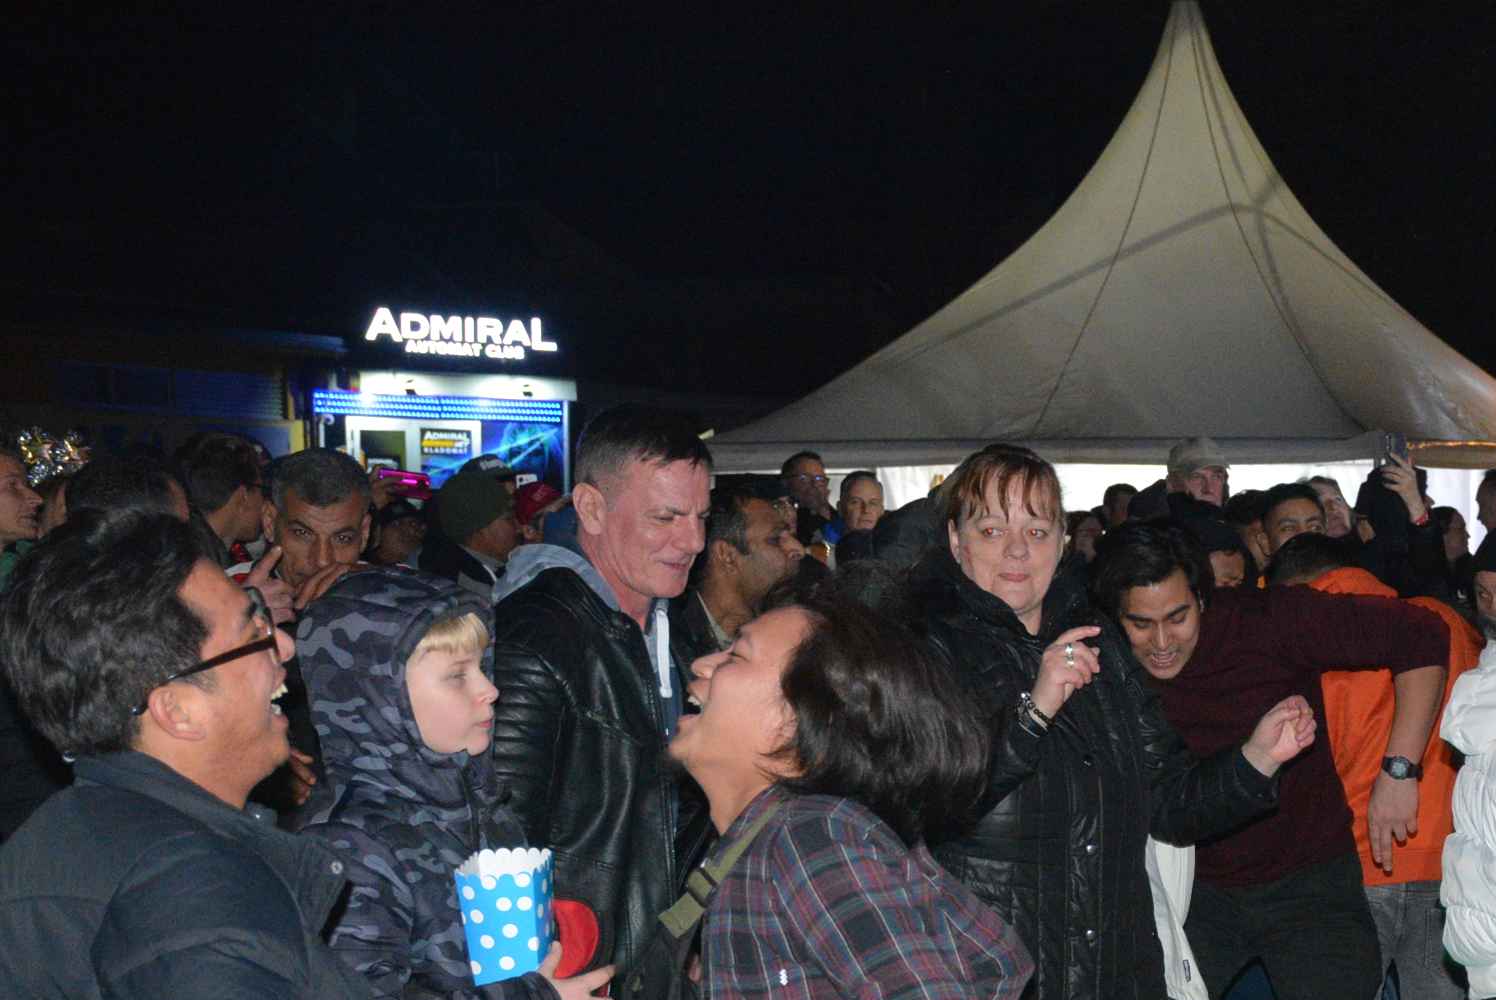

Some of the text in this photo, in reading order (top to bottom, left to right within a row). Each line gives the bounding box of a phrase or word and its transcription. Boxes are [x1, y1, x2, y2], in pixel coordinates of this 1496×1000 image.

[365, 307, 558, 351] ADMIRAL
[405, 340, 525, 360] AUTOMAT CLUB
[424, 430, 470, 442] ADMIRAL
